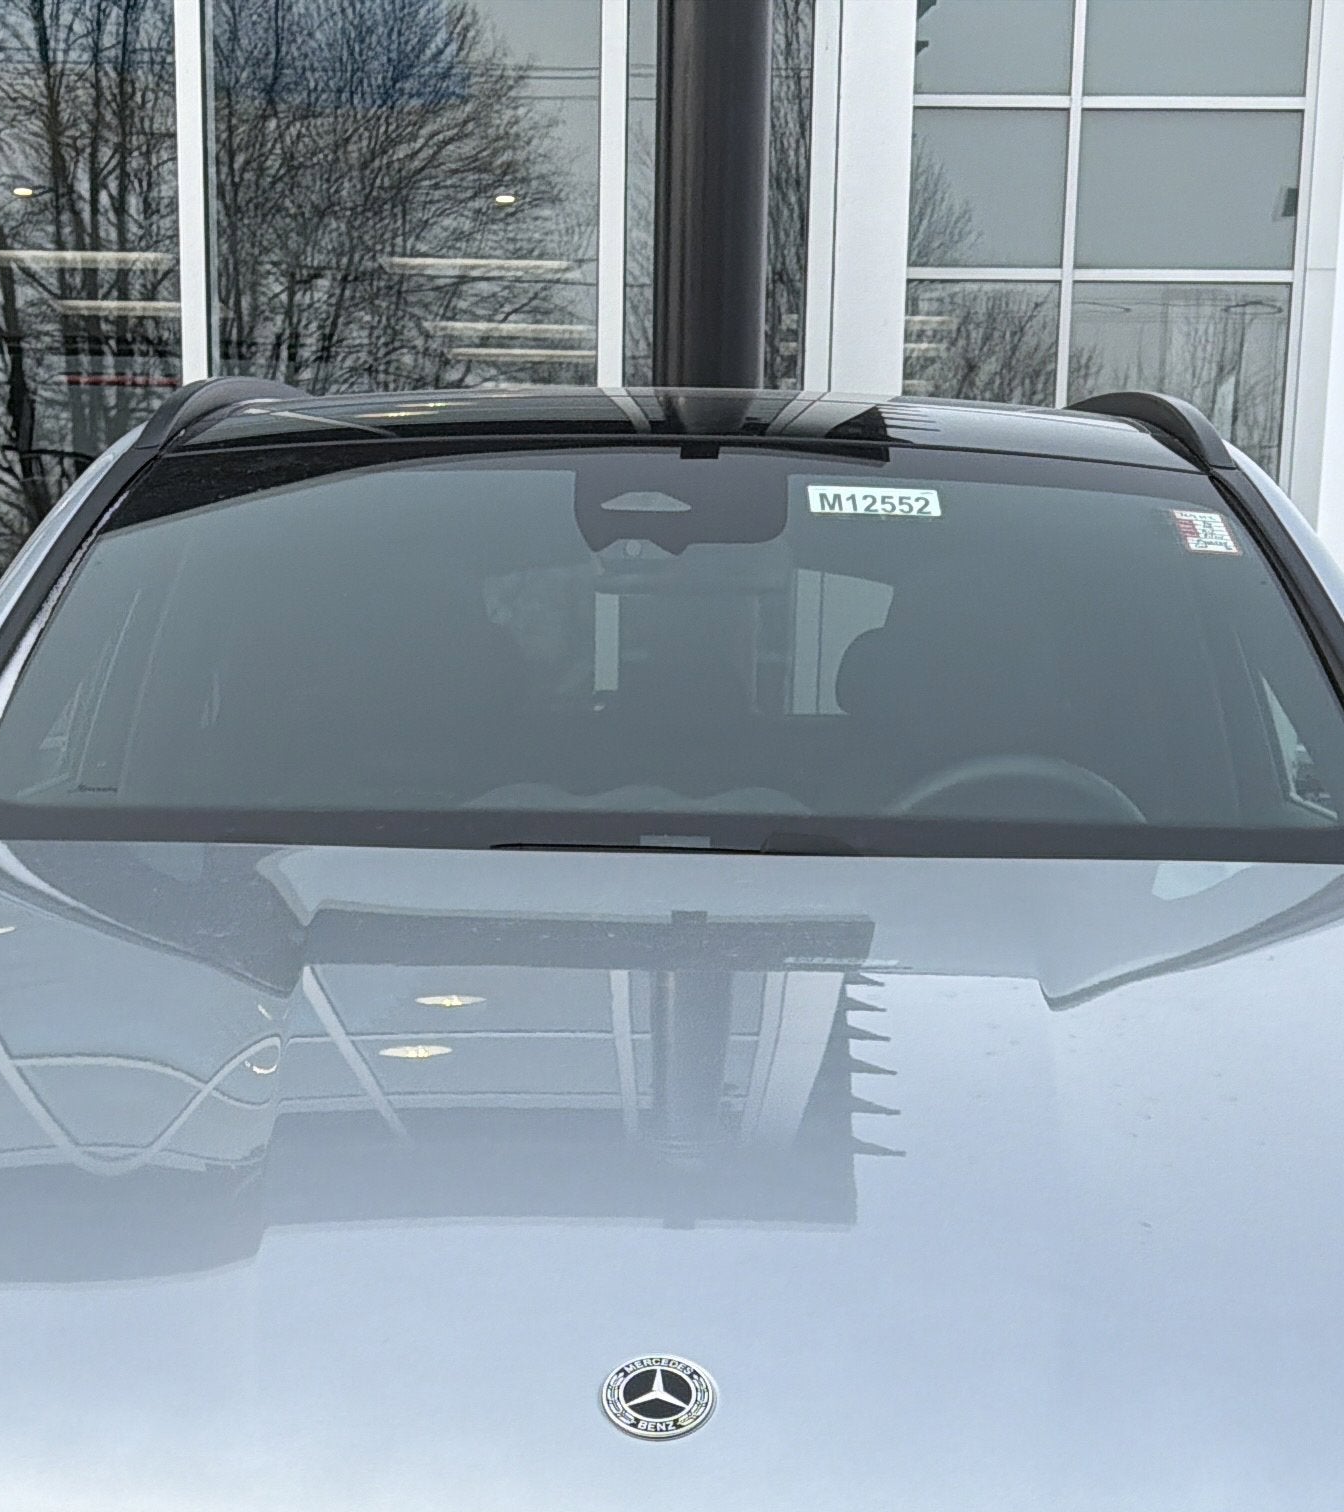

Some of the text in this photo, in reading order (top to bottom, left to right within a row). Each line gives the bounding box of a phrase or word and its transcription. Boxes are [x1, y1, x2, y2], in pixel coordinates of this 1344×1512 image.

[818, 492, 933, 515] M12552
[623, 1358, 694, 1375] MERCEDES
[637, 1420, 677, 1432] BENZ
